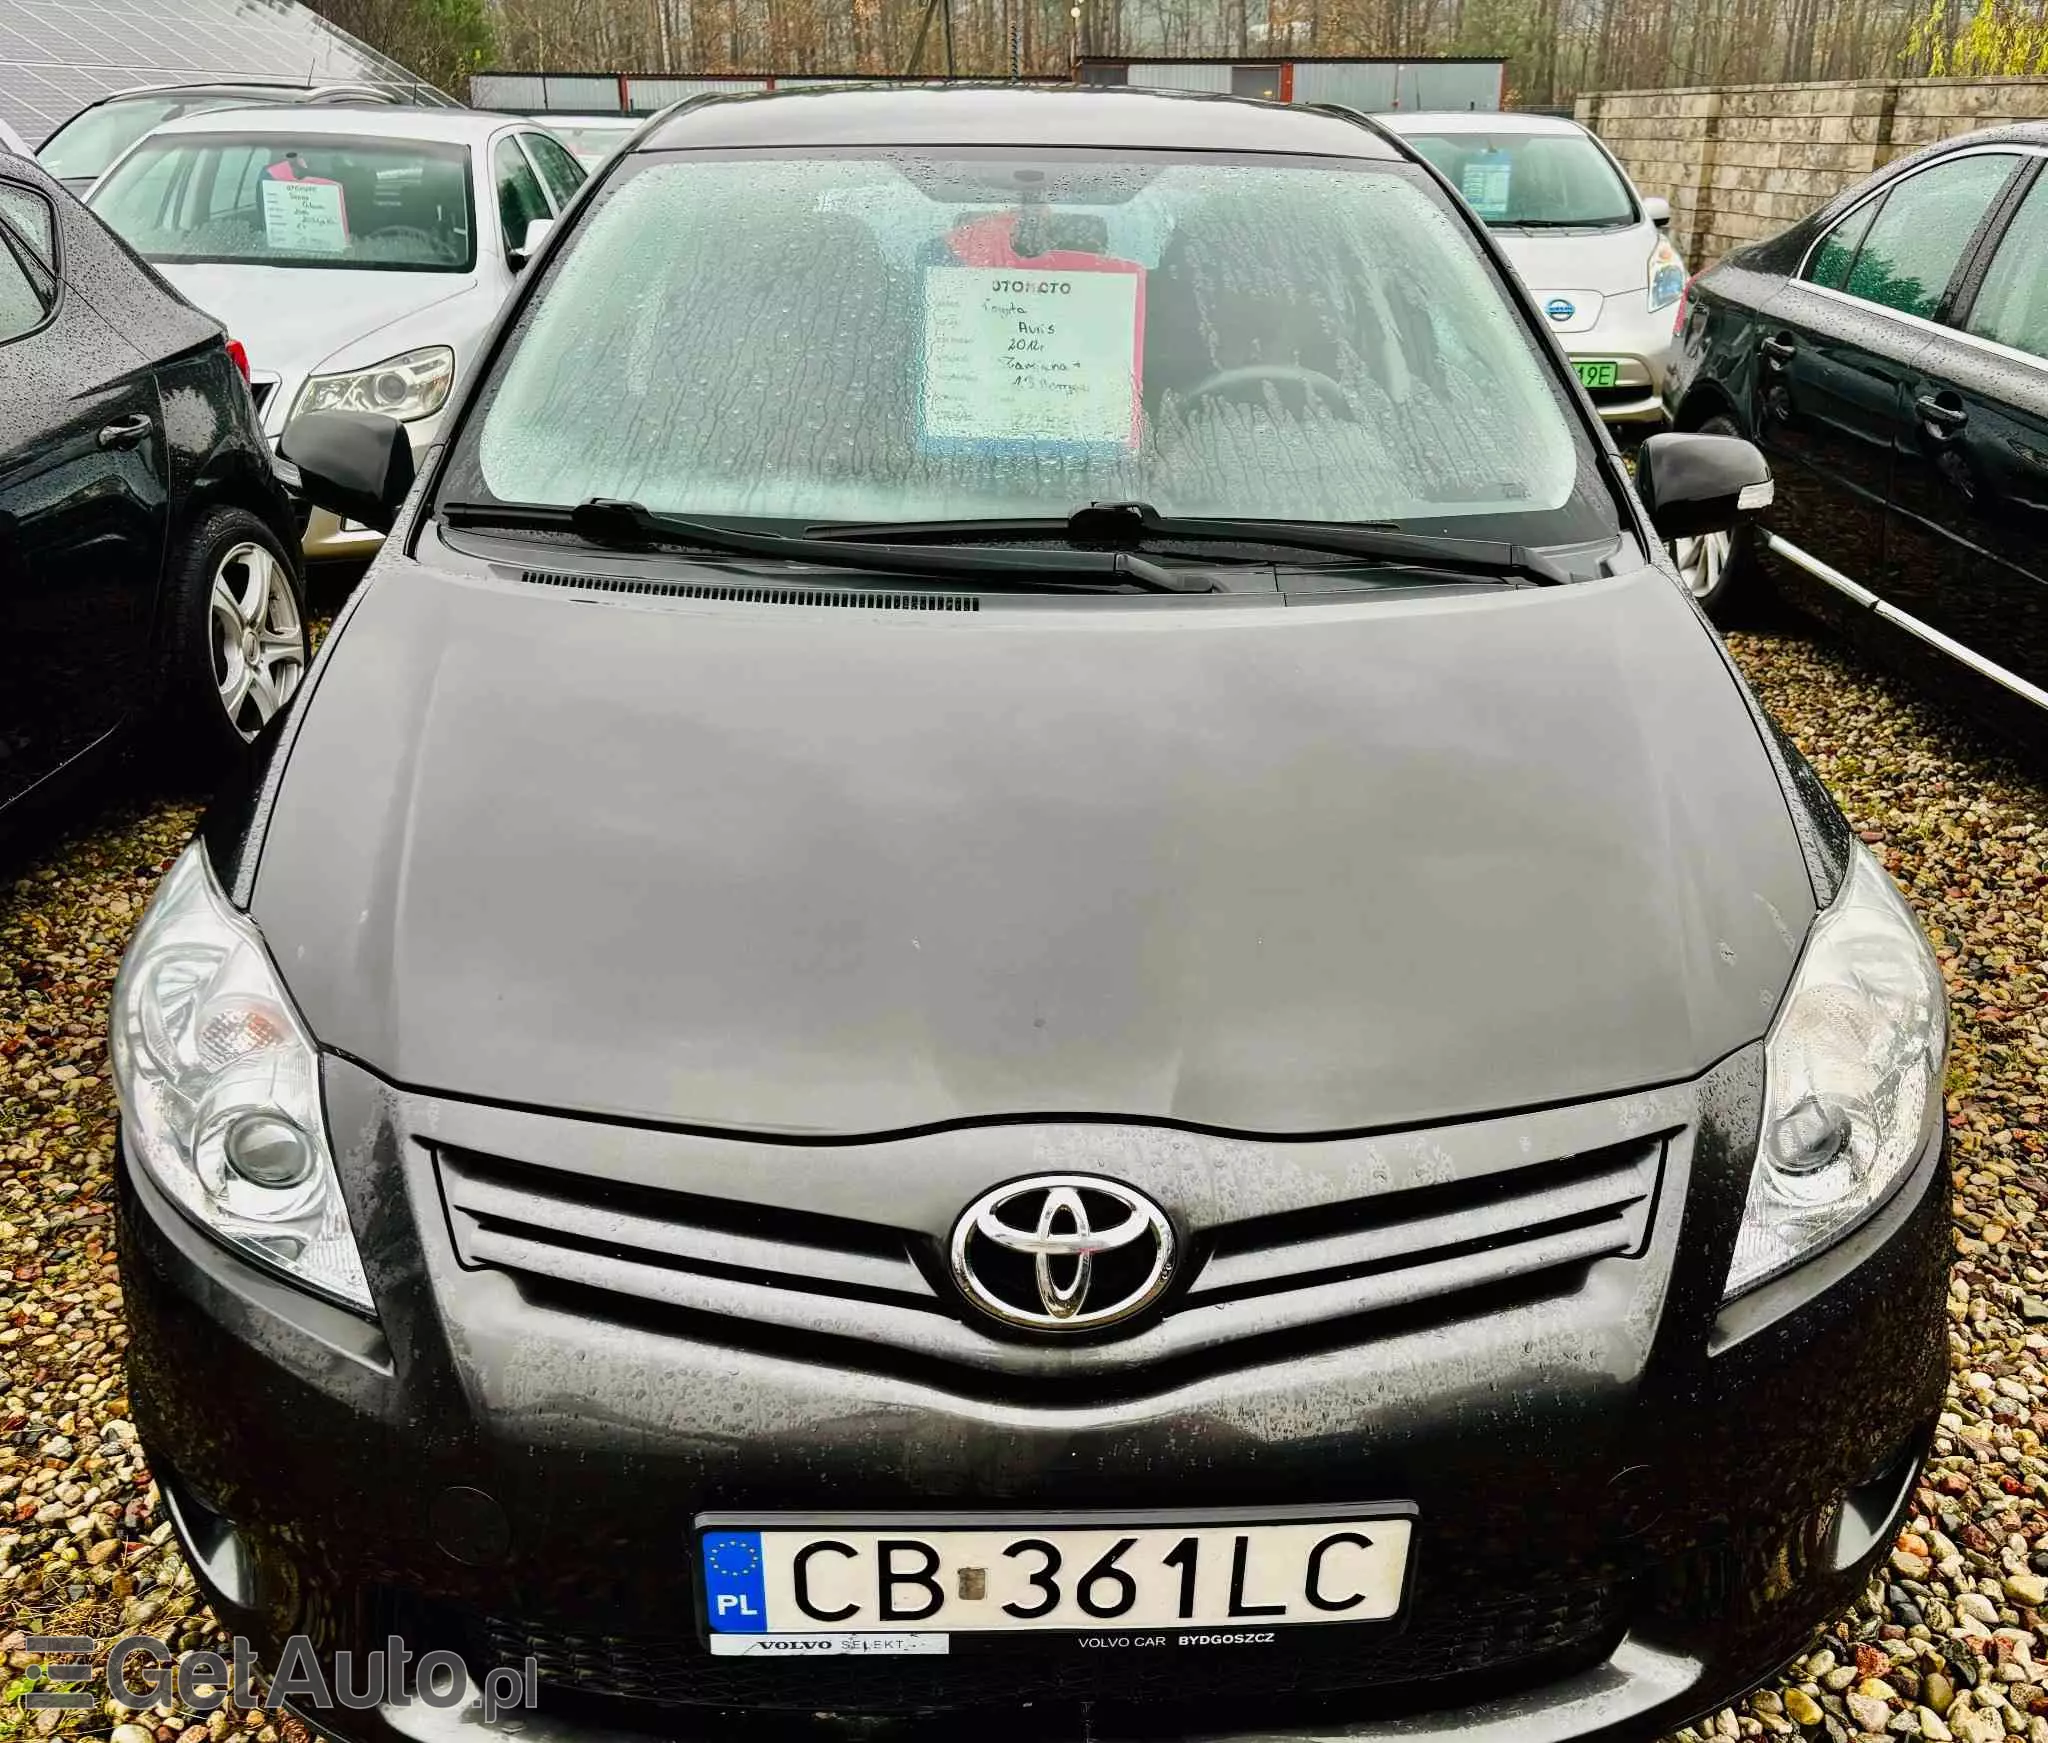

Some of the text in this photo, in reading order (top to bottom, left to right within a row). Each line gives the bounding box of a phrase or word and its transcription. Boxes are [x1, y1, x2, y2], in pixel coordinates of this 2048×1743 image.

[793, 1532, 1374, 1622] CB 361LC
[717, 1594, 758, 1616] PL
[757, 1640, 904, 1652] VOLVO SELEKT
[1078, 1632, 1275, 1648] VOLVO CAR BYDGOSZCZ
